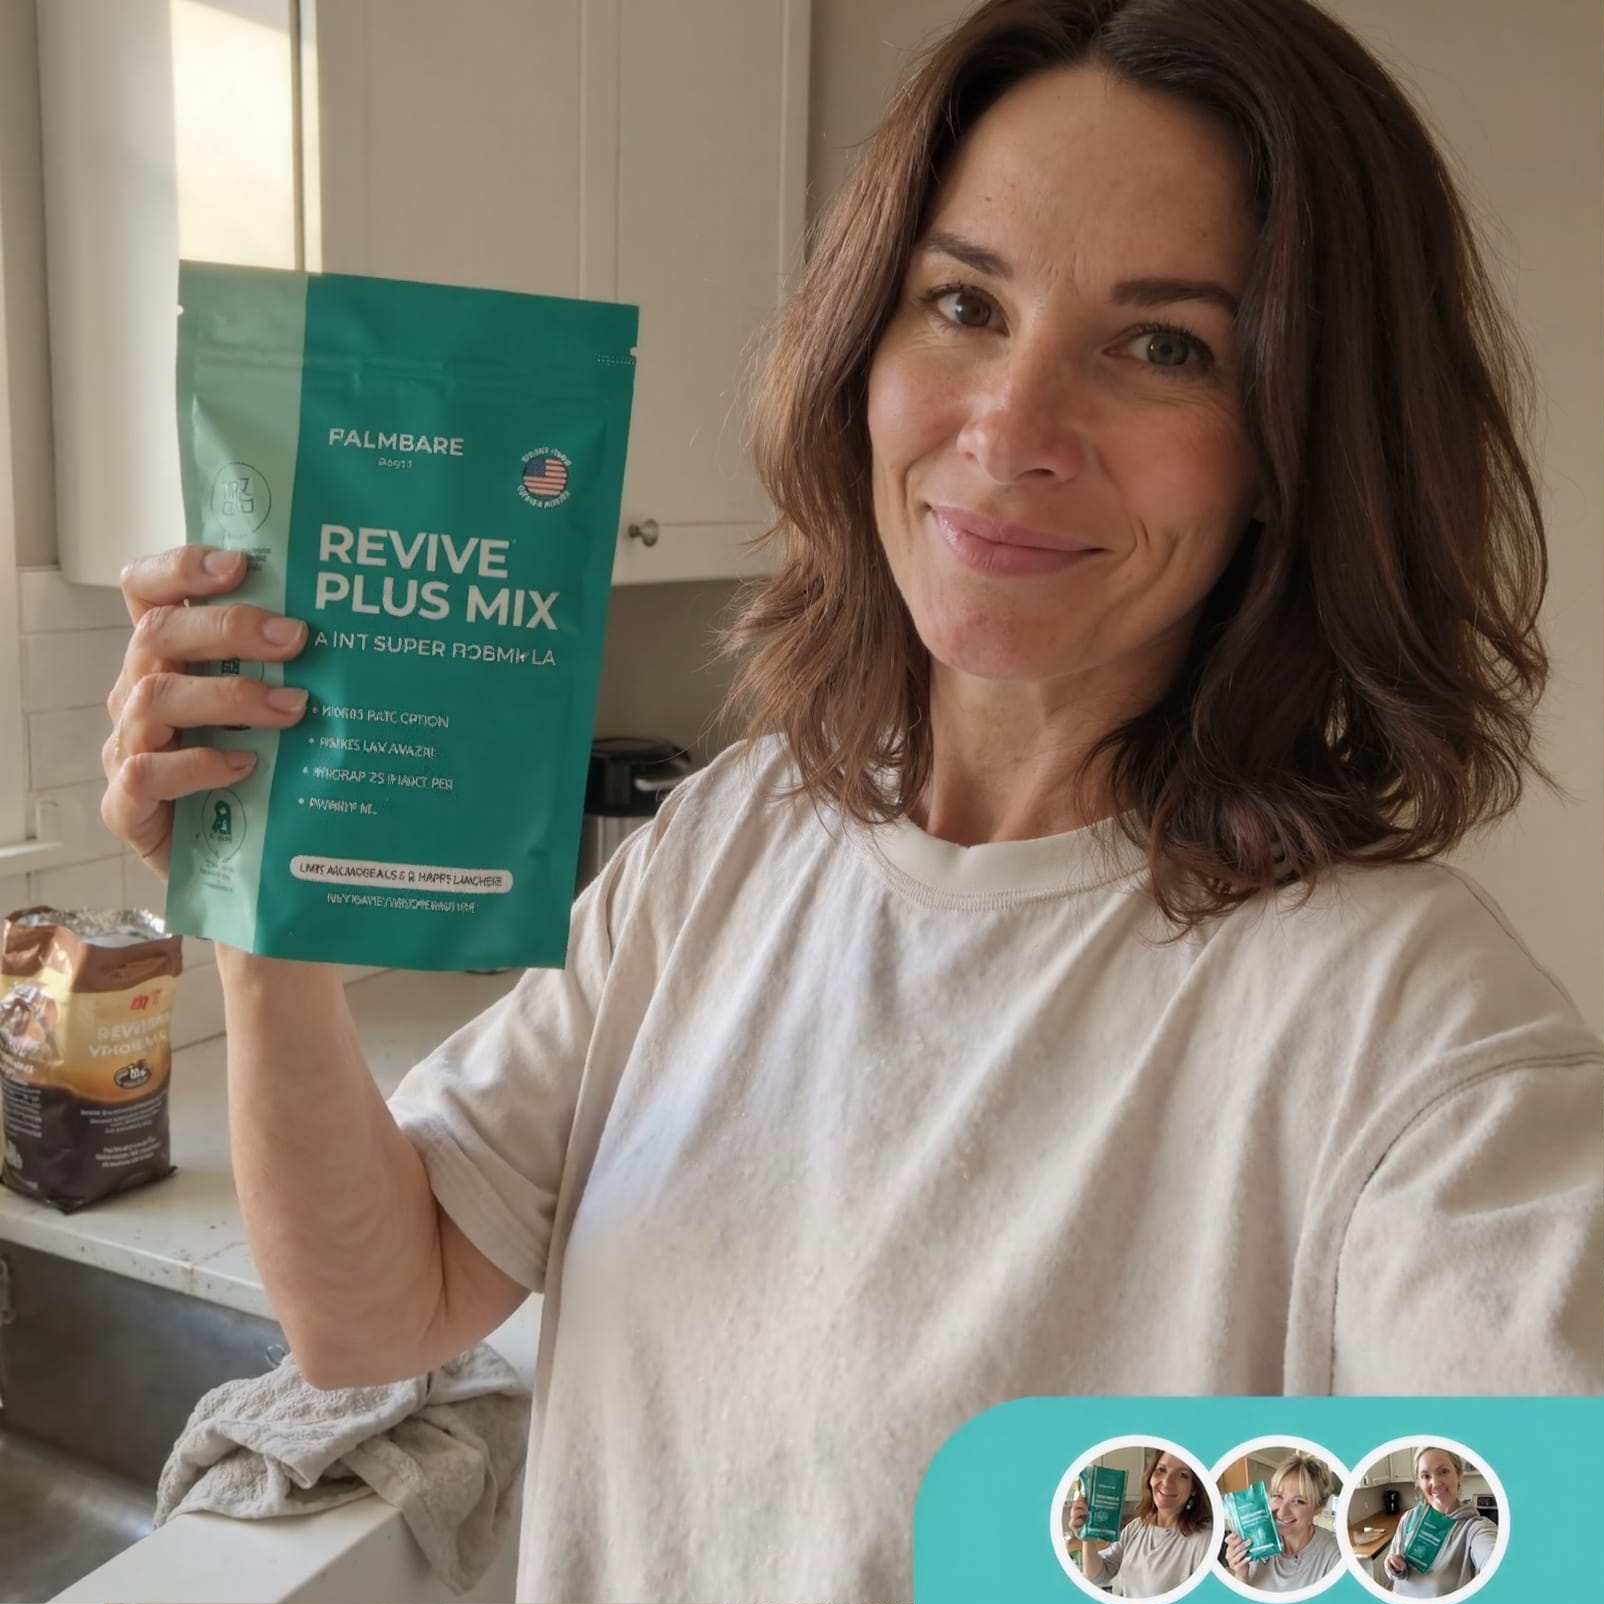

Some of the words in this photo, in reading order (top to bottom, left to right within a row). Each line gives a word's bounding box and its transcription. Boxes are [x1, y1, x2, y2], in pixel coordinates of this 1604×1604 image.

[319, 523, 511, 579] REVIVE
[315, 571, 451, 620] PLUS
[466, 584, 560, 631] MIX
[373, 635, 446, 657] SUPER
